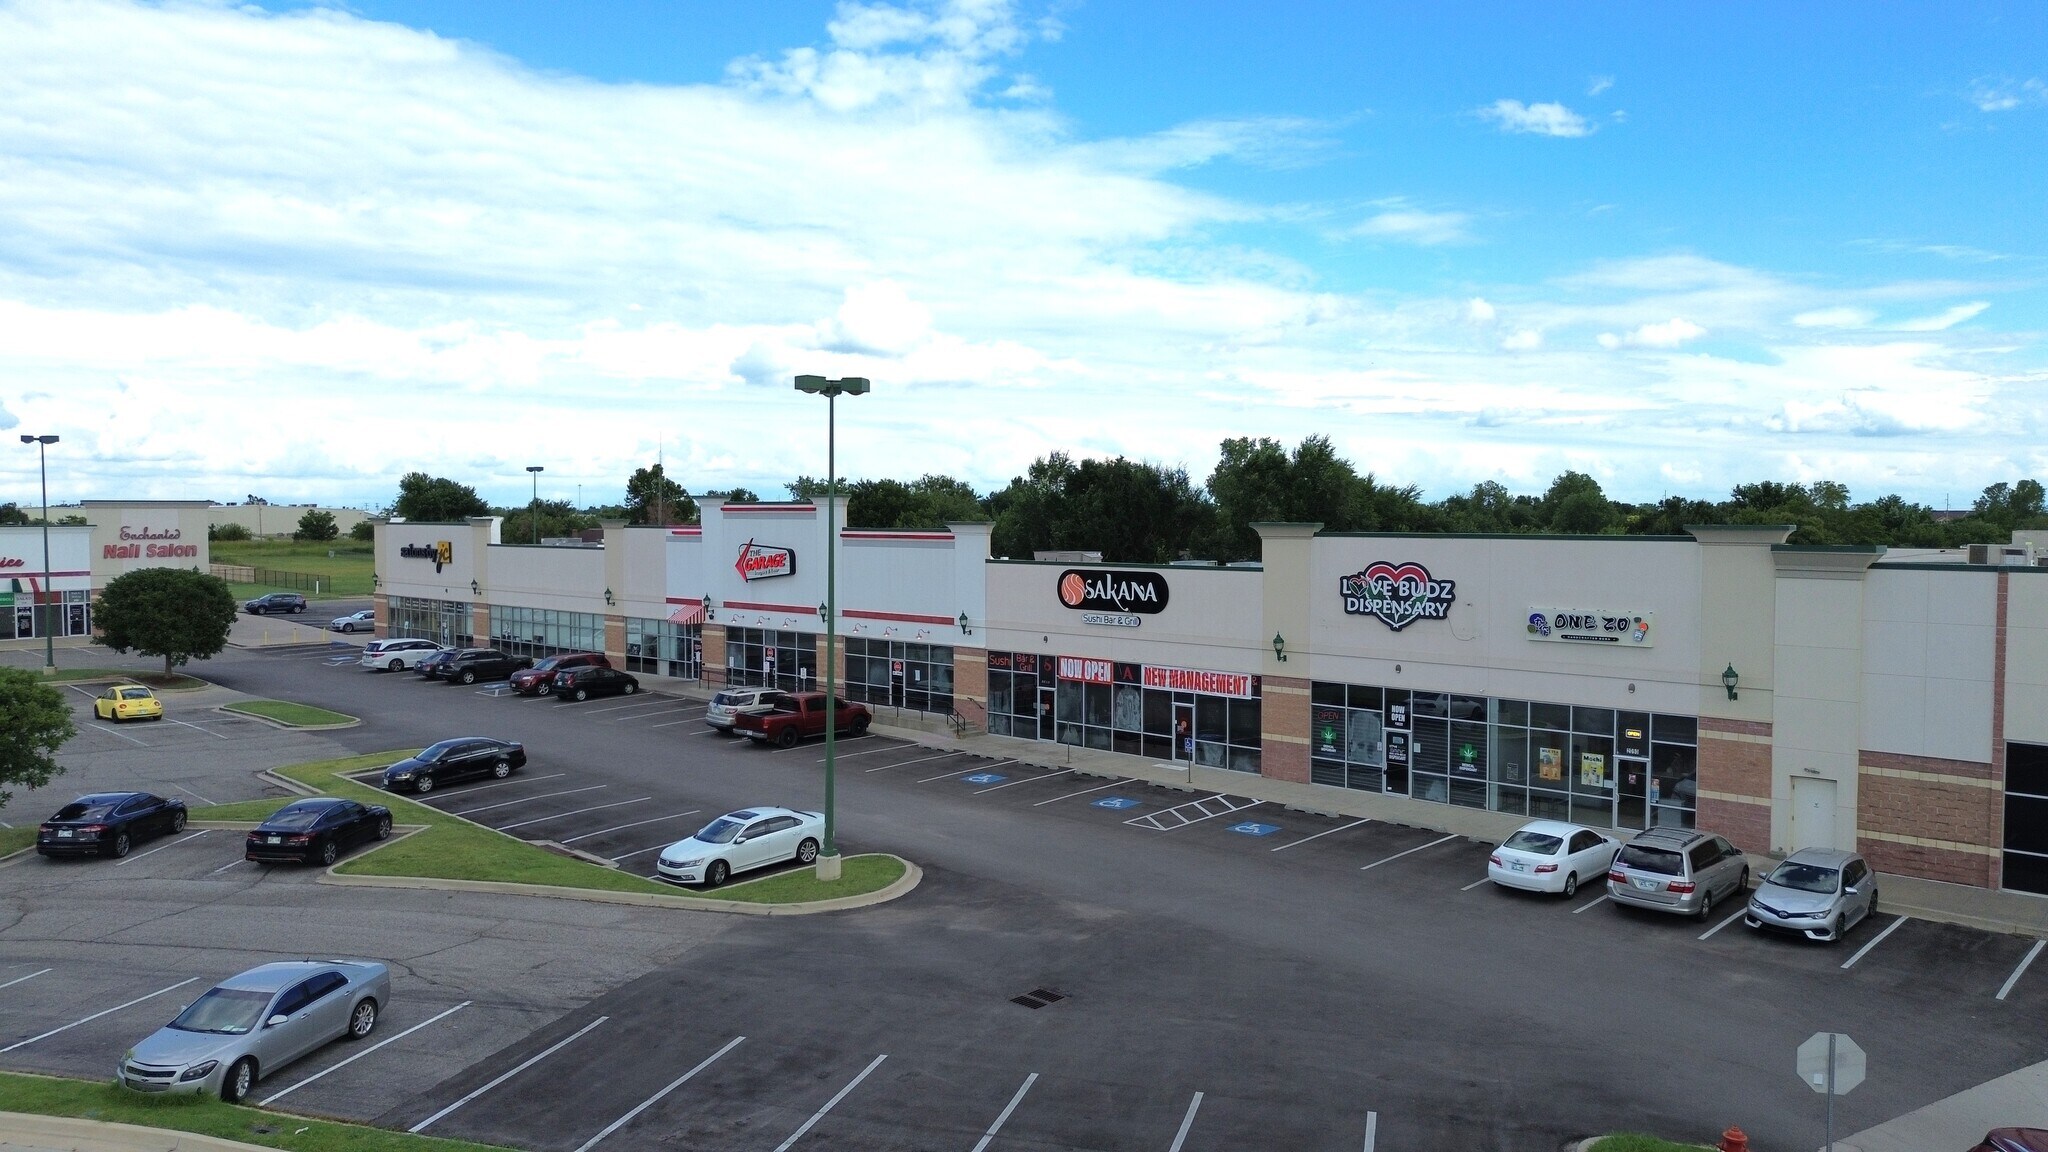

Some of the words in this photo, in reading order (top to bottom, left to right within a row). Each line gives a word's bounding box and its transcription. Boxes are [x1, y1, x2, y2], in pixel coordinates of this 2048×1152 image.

[119, 525, 181, 541] Enchanted
[103, 543, 140, 559] Nail
[146, 543, 197, 558] Salon
[750, 549, 762, 557] THE
[744, 553, 787, 571] GARAGE
[1084, 573, 1158, 612] SAKANA
[1399, 581, 1453, 599] BUDZ
[1347, 597, 1448, 617] DISPENSARY
[1083, 614, 1103, 624] Sushi
[1104, 616, 1117, 624] Bar
[1118, 617, 1123, 625] &
[1124, 617, 1138, 626] Grill
[1554, 613, 1597, 631] ONE
[1601, 616, 1631, 633] ZO
[1060, 658, 1083, 678] NOW
[1084, 660, 1111, 682] OPEN
[1144, 667, 1167, 688] NEW
[1169, 669, 1249, 696] MANAGEMENT
[1391, 705, 1405, 714] NOW
[1391, 713, 1406, 722] OPEN
